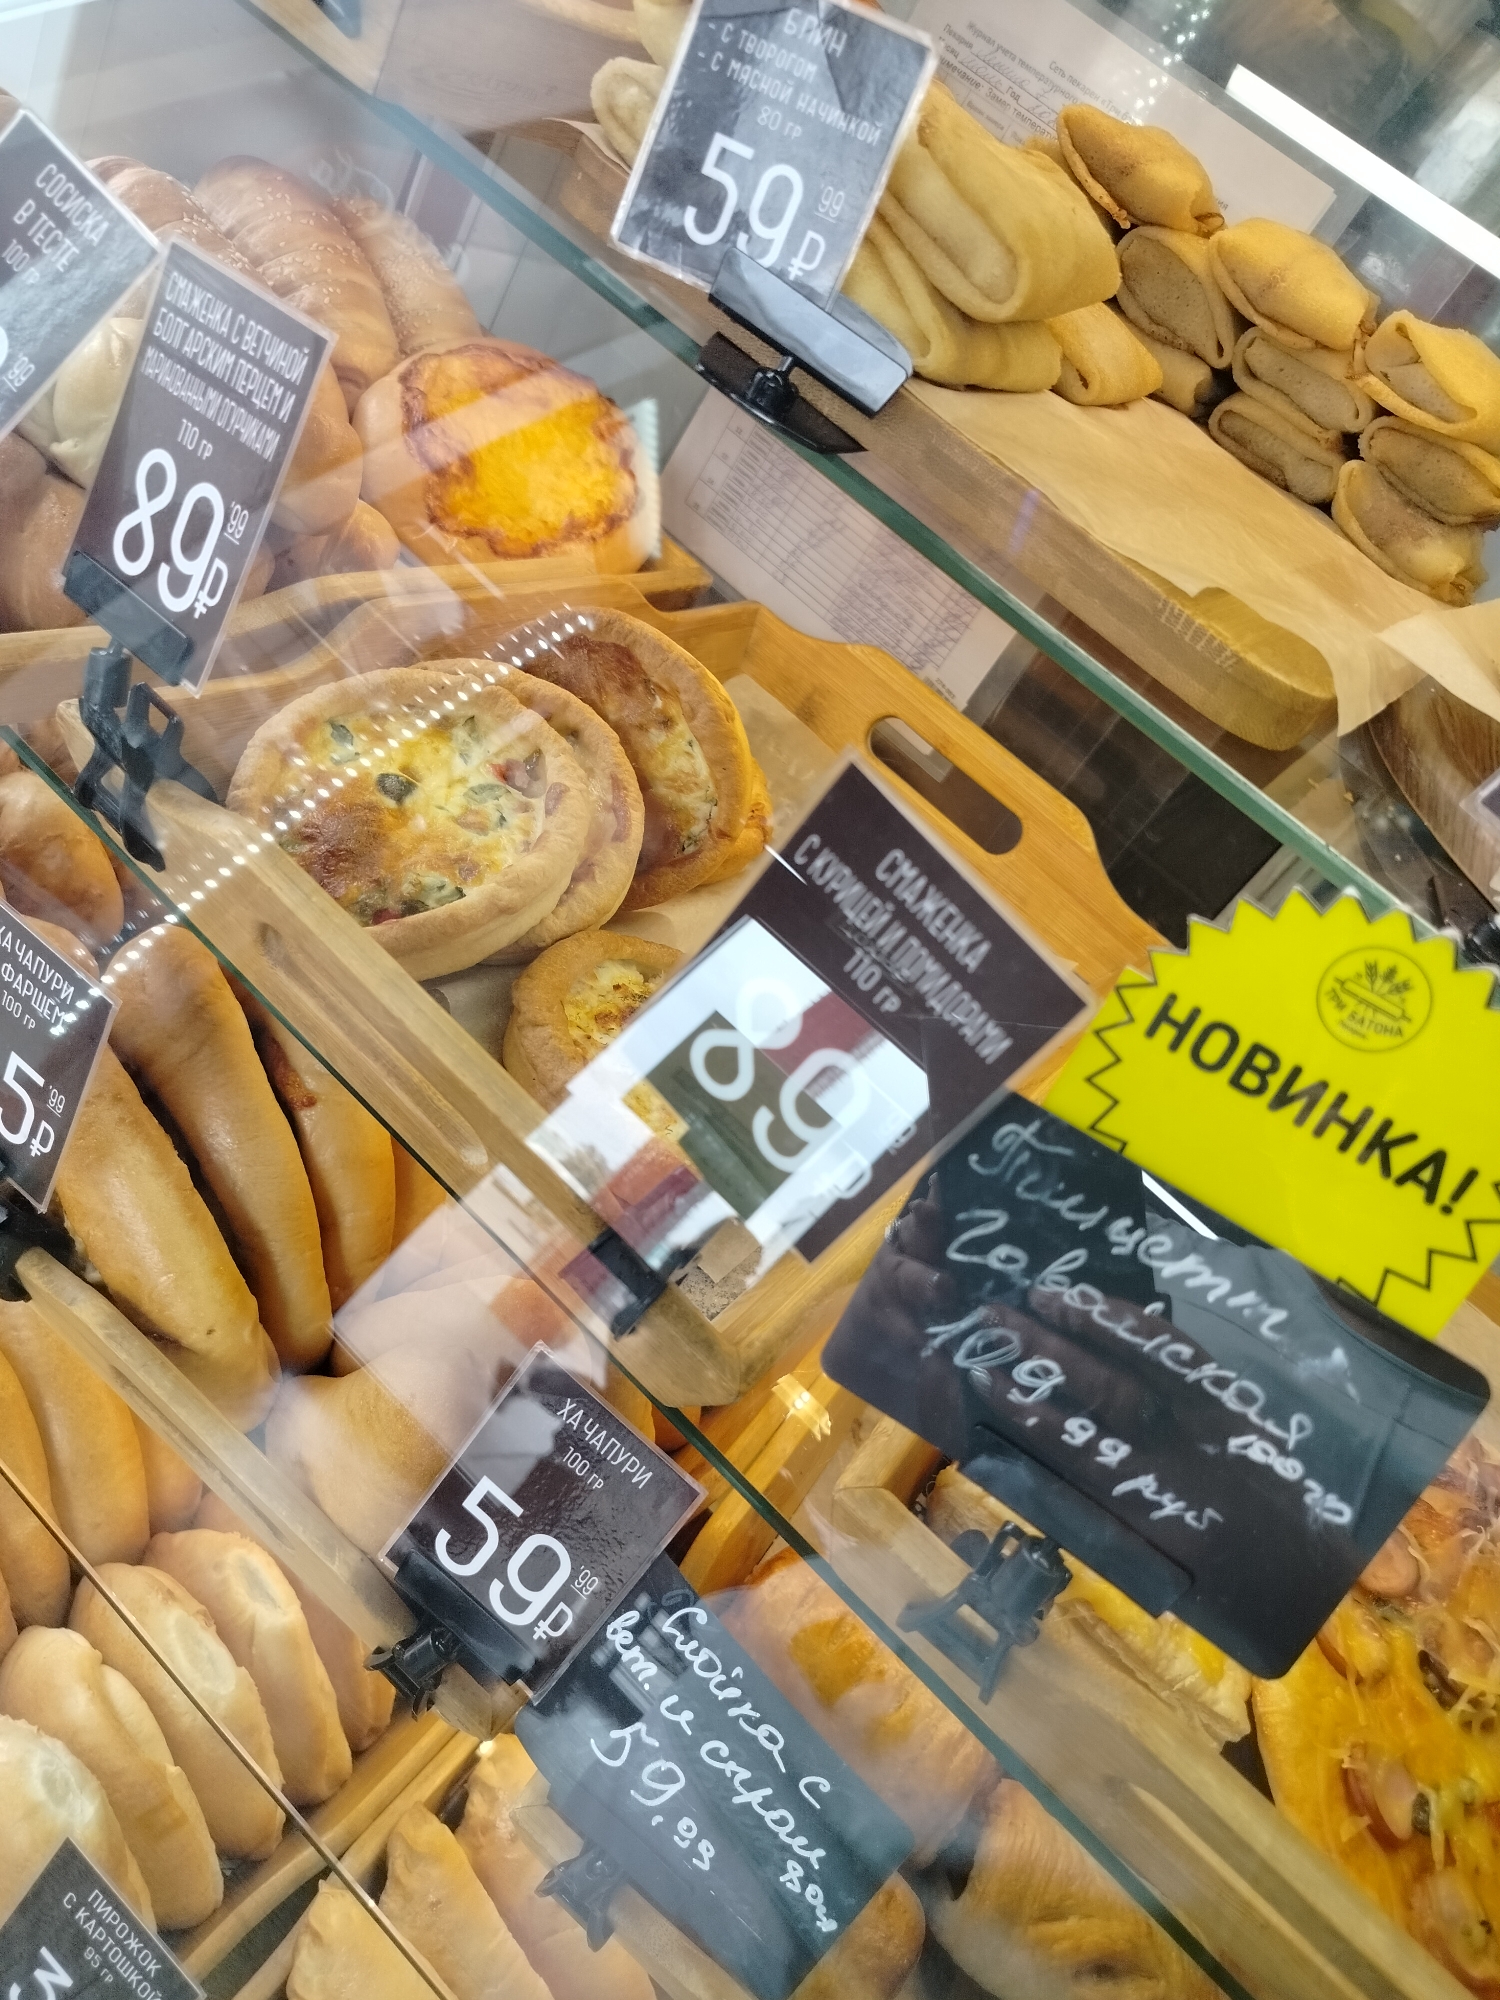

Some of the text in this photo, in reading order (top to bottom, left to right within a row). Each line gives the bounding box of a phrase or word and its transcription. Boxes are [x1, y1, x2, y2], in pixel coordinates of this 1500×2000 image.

[721, 22, 735, 44] С
[737, 29, 819, 83] ТВОРОГОМ
[942, 24, 975, 50] Пекарня
[965, 21, 998, 48] Журнал
[710, 50, 724, 71] С
[727, 58, 796, 108] МЯСНОЙ
[796, 92, 884, 147] НАЧИНКОЙ
[936, 54, 985, 92] имечание:
[984, 87, 1013, 112] Замер
[1047, 60, 1069, 79] Сеть
[1062, 74, 1101, 104] пекарен
[757, 106, 780, 131] 80
[35, 164, 110, 248] СОСИСКА
[683, 132, 804, 268] 59
[1, 238, 30, 272] 100
[13, 199, 81, 273] В ТЕСТЕ
[164, 270, 311, 387] СМАЖЕНКА С ВЕТЧИНОЙ
[153, 307, 297, 424] БОЛГАРСКИМ ПЕРЦЕМ И
[140, 344, 281, 462] МАРИНОВАННЫМИ ОГУРЧИКАМИ
[177, 418, 200, 451] 110
[112, 448, 225, 613] 89
[875, 848, 992, 974] СМАЖЕНКА
[793, 834, 821, 866] С
[807, 846, 894, 939] КУРИЦЕЙ
[892, 938, 1014, 1065] ПОМИДОРАМИ
[843, 948, 883, 993] 110
[1, 962, 65, 1028] ФАРШЕМ
[2, 989, 22, 1021] 100
[1347, 1010, 1405, 1039] БАТОНА
[688, 976, 872, 1175] 89
[1143, 992, 1479, 1215] НОВИНКА!
[556, 1397, 654, 1490] ХАЧАПУРИ
[562, 1445, 589, 1477] 100
[1111, 1472, 1224, 1533] руб
[434, 1474, 572, 1626] 59
[63, 1892, 77, 1909] С
[88, 1889, 161, 1978] ПИРОЖОК
[84, 1946, 102, 1968] 95
